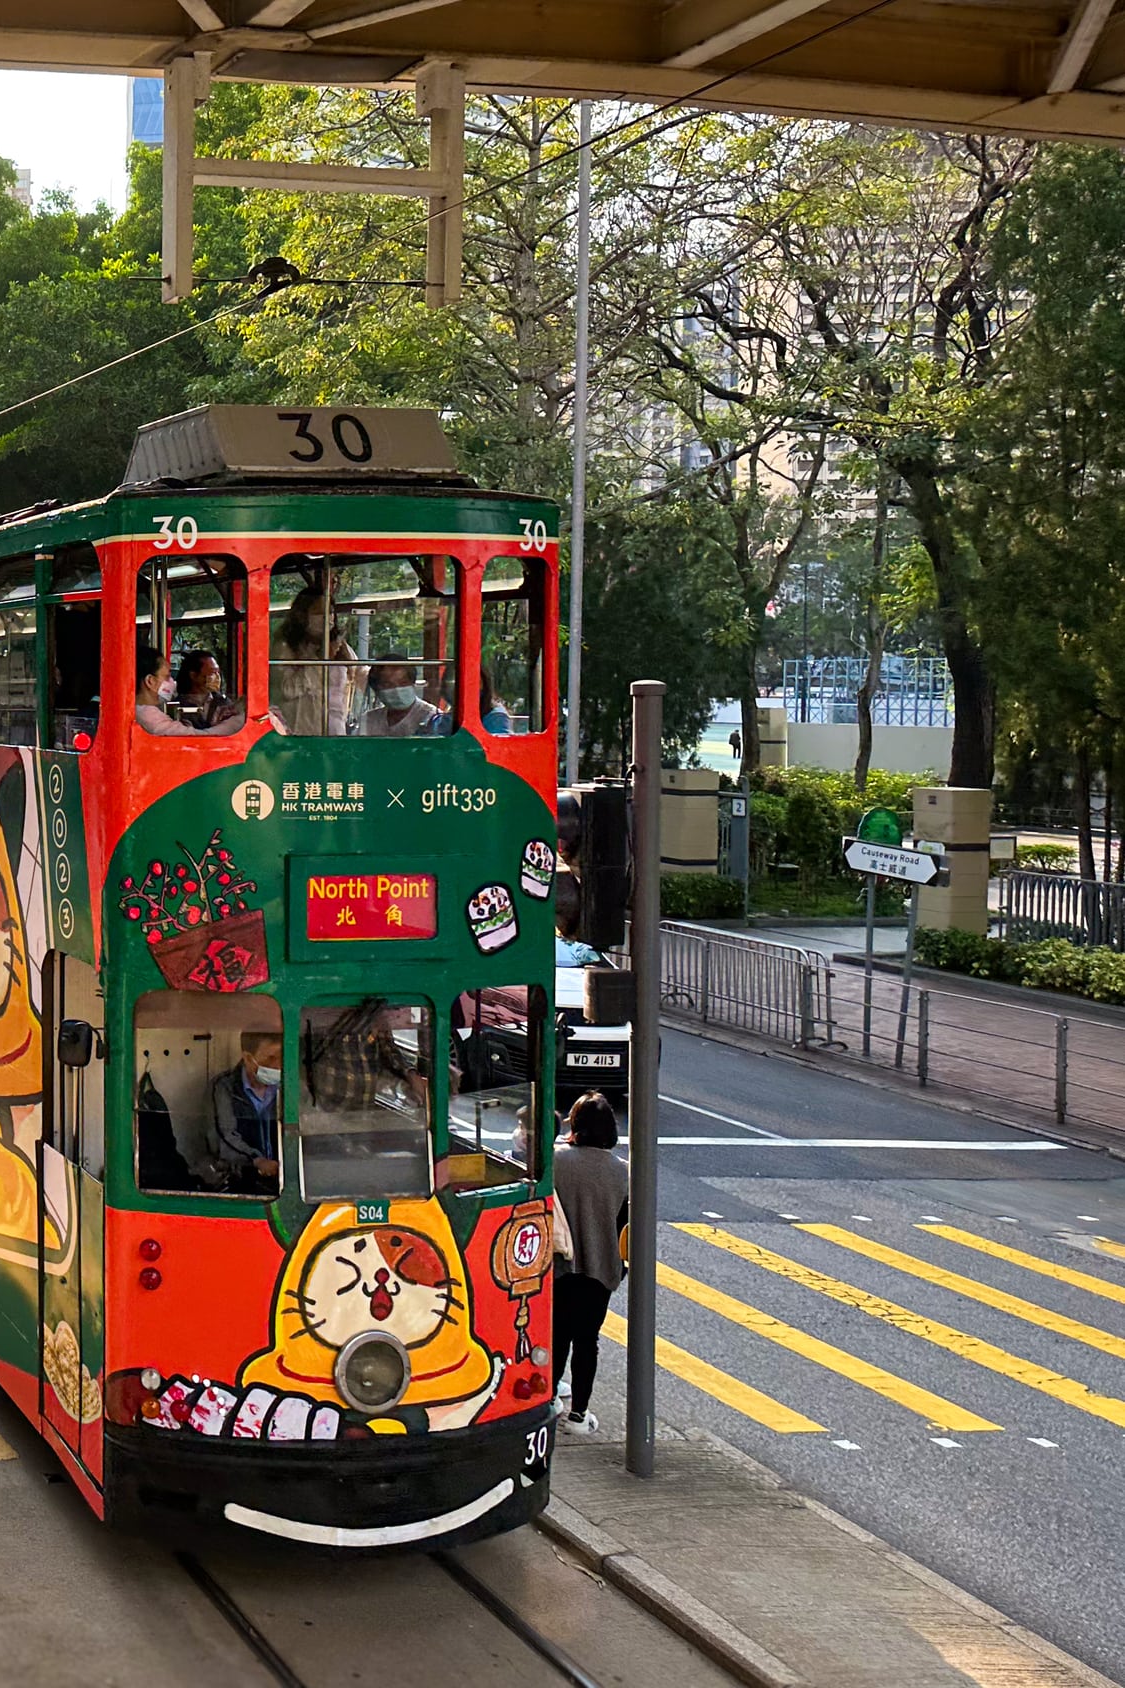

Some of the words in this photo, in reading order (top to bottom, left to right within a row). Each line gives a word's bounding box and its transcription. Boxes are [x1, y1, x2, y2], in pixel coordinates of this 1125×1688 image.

[277, 413, 372, 463] 30
[152, 516, 198, 550] 30
[518, 518, 547, 552] 30
[281, 782, 365, 800] 香港電車
[422, 783, 496, 813] gift330
[281, 803, 298, 812] HK
[300, 802, 365, 812] TRAMWAYS
[735, 802, 742, 812] 2
[860, 846, 898, 862] Causeway
[899, 853, 920, 866] Road
[309, 877, 368, 899] North
[376, 875, 430, 899] Point
[335, 904, 403, 927] 北角
[593, 1055, 615, 1066] 4113
[359, 1205, 383, 1220] S04
[524, 1426, 548, 1465] 30
